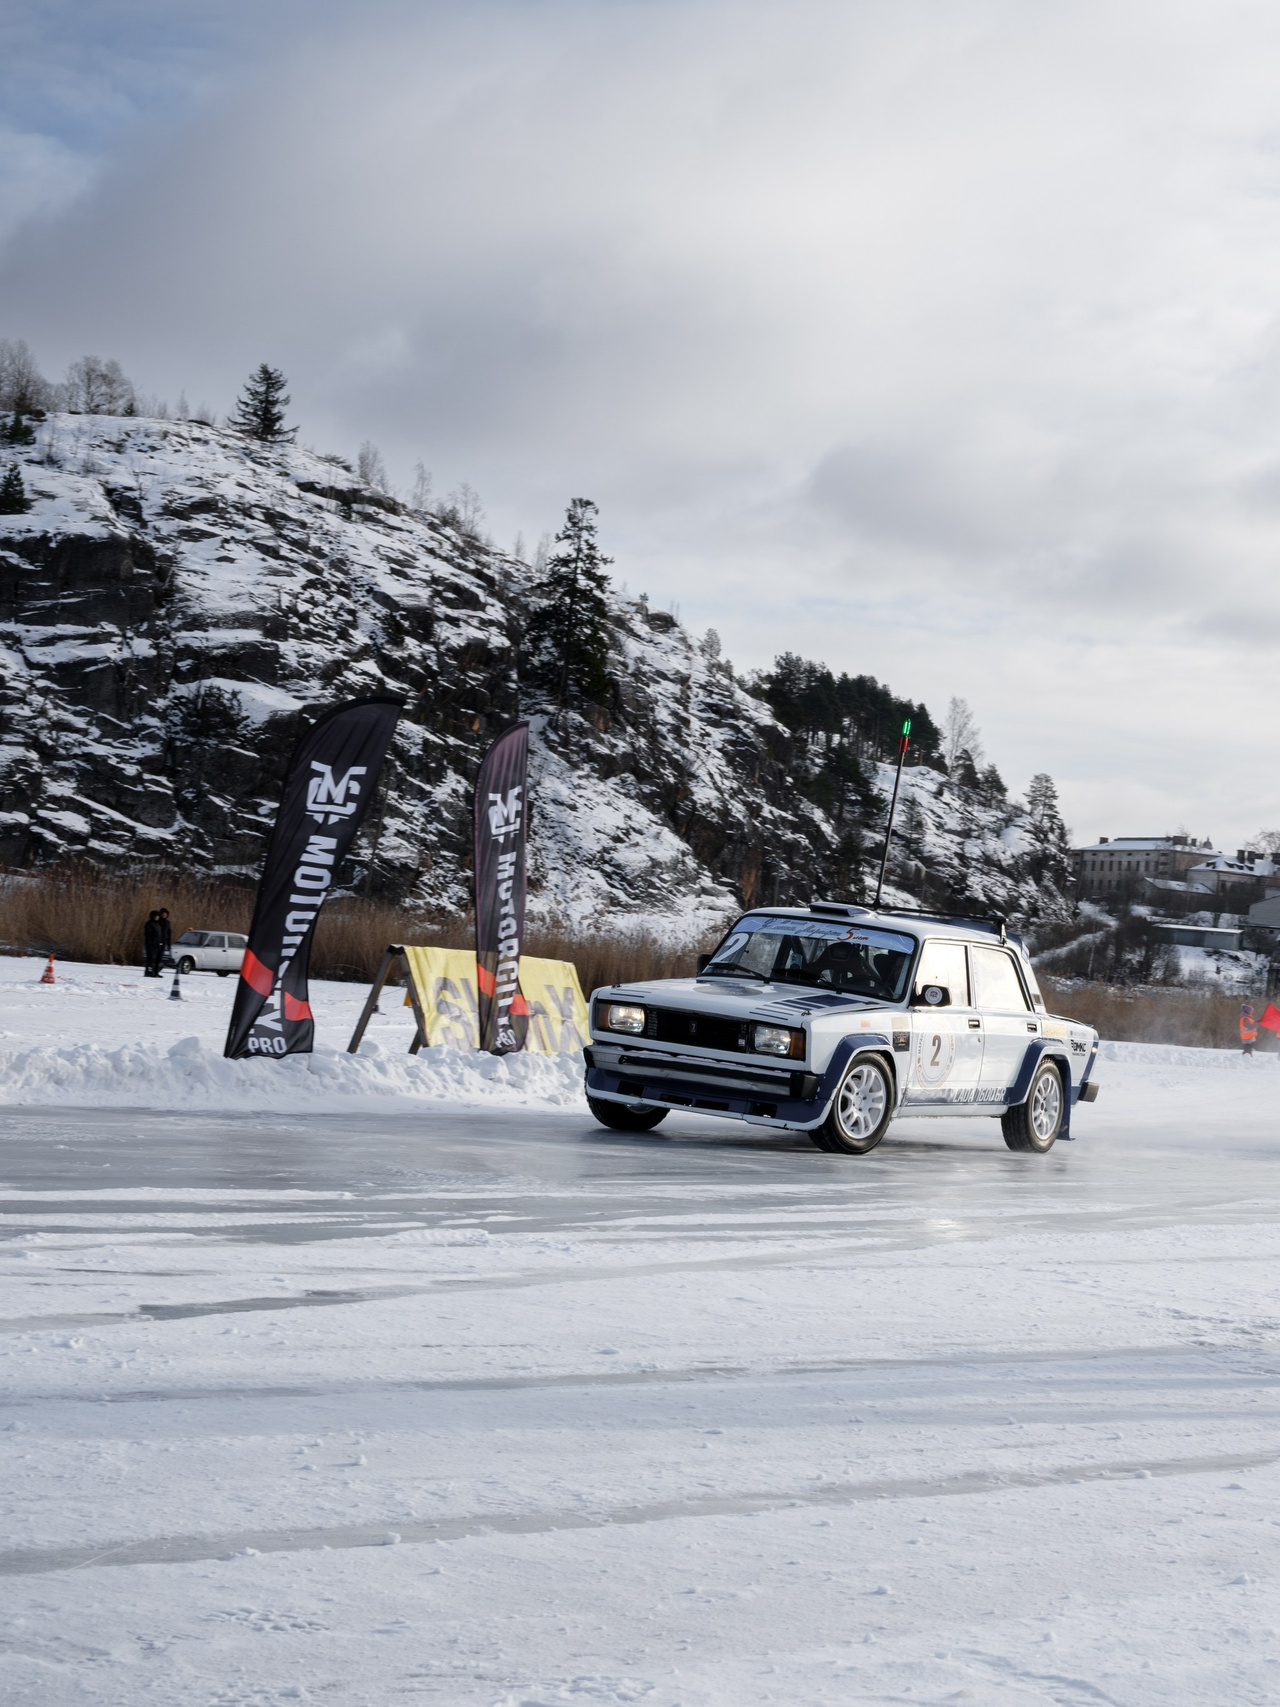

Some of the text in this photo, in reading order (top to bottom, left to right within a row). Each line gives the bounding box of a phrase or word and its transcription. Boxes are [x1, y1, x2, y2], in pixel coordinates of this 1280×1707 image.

[837, 927, 860, 941] 5
[709, 932, 749, 963] 2
[248, 1037, 287, 1054] PRO
[930, 1034, 942, 1067] 2
